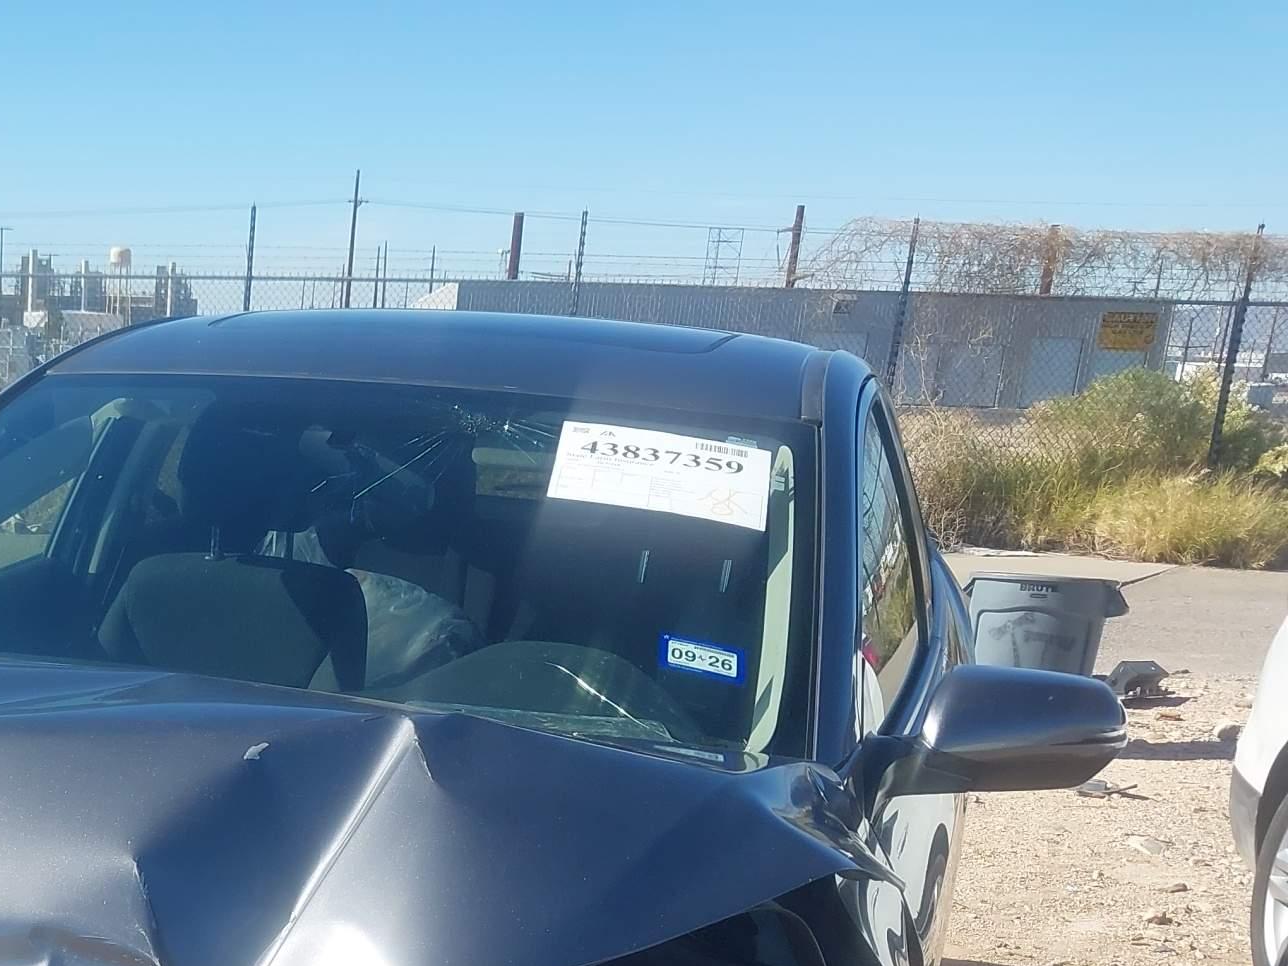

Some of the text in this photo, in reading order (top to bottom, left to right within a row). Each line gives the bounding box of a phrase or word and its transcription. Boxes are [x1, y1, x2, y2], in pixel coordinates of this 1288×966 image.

[580, 439, 744, 475] 43837359
[671, 647, 696, 662] 09
[708, 655, 733, 671] 26
